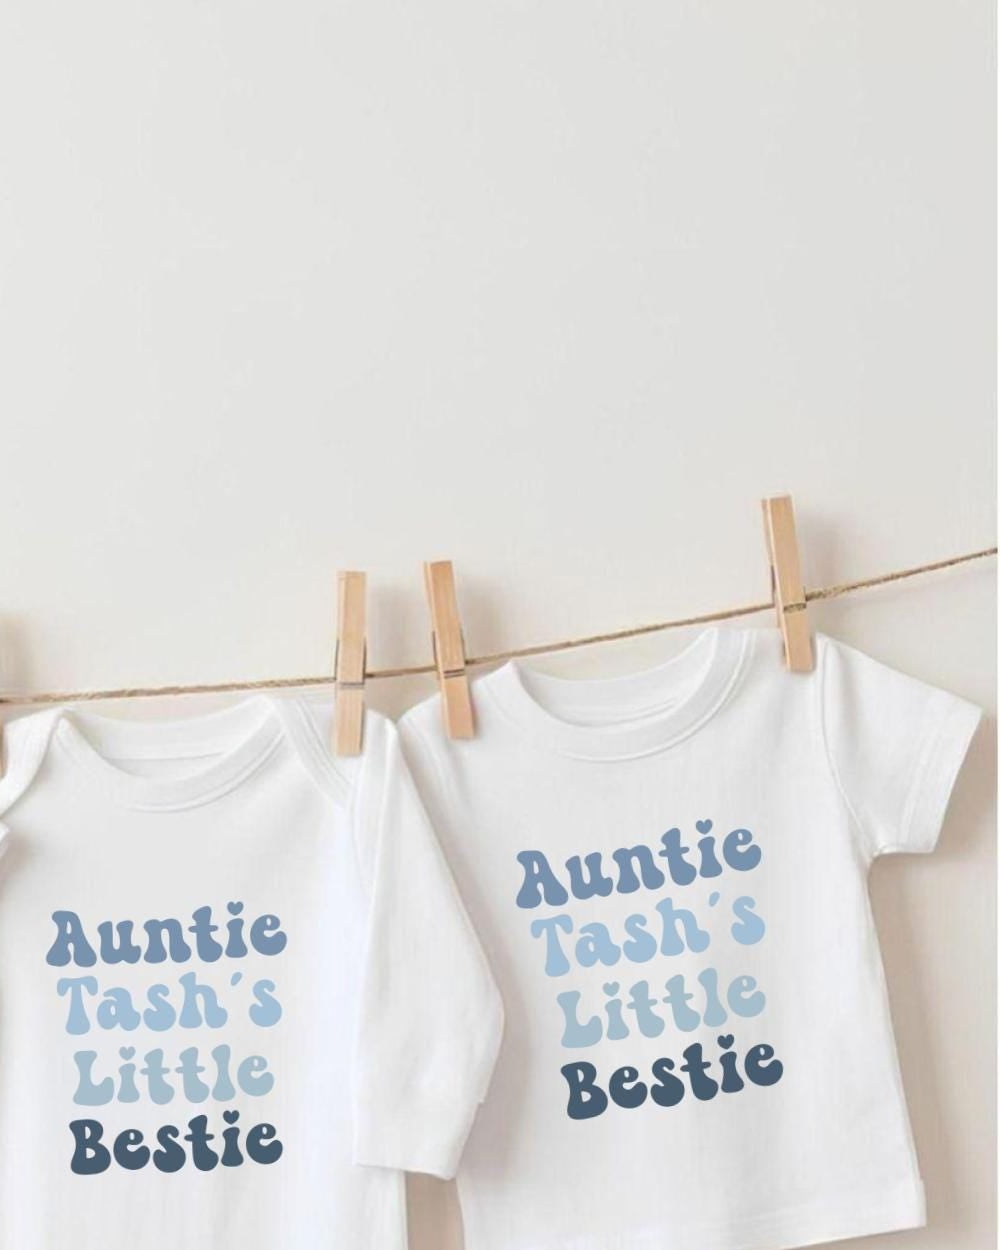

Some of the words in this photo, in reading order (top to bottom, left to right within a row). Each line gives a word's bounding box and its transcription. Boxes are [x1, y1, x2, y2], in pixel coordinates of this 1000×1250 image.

[514, 819, 764, 911] Auntie
[44, 900, 290, 970] Auntie
[556, 967, 767, 1050] Little
[71, 1043, 277, 1109] Little
[559, 1034, 785, 1122] Bestie
[70, 1110, 286, 1177] Bestie
